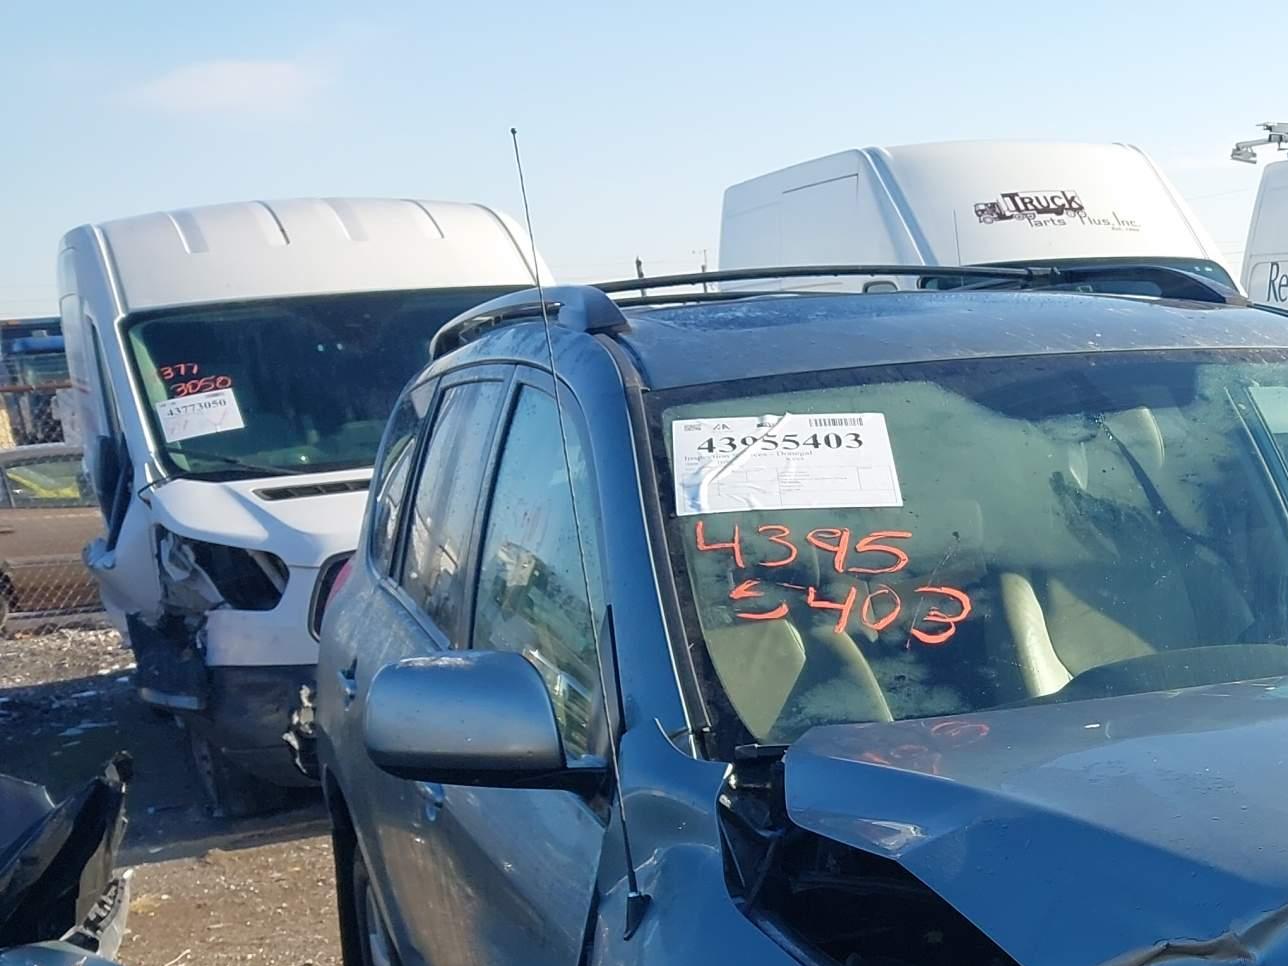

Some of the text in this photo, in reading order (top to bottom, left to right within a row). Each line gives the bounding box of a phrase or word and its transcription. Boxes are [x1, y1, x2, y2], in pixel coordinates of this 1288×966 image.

[170, 375, 232, 397] 3050
[167, 399, 227, 417] 43773050
[697, 432, 864, 454] 43955403
[694, 520, 913, 575] 4395
